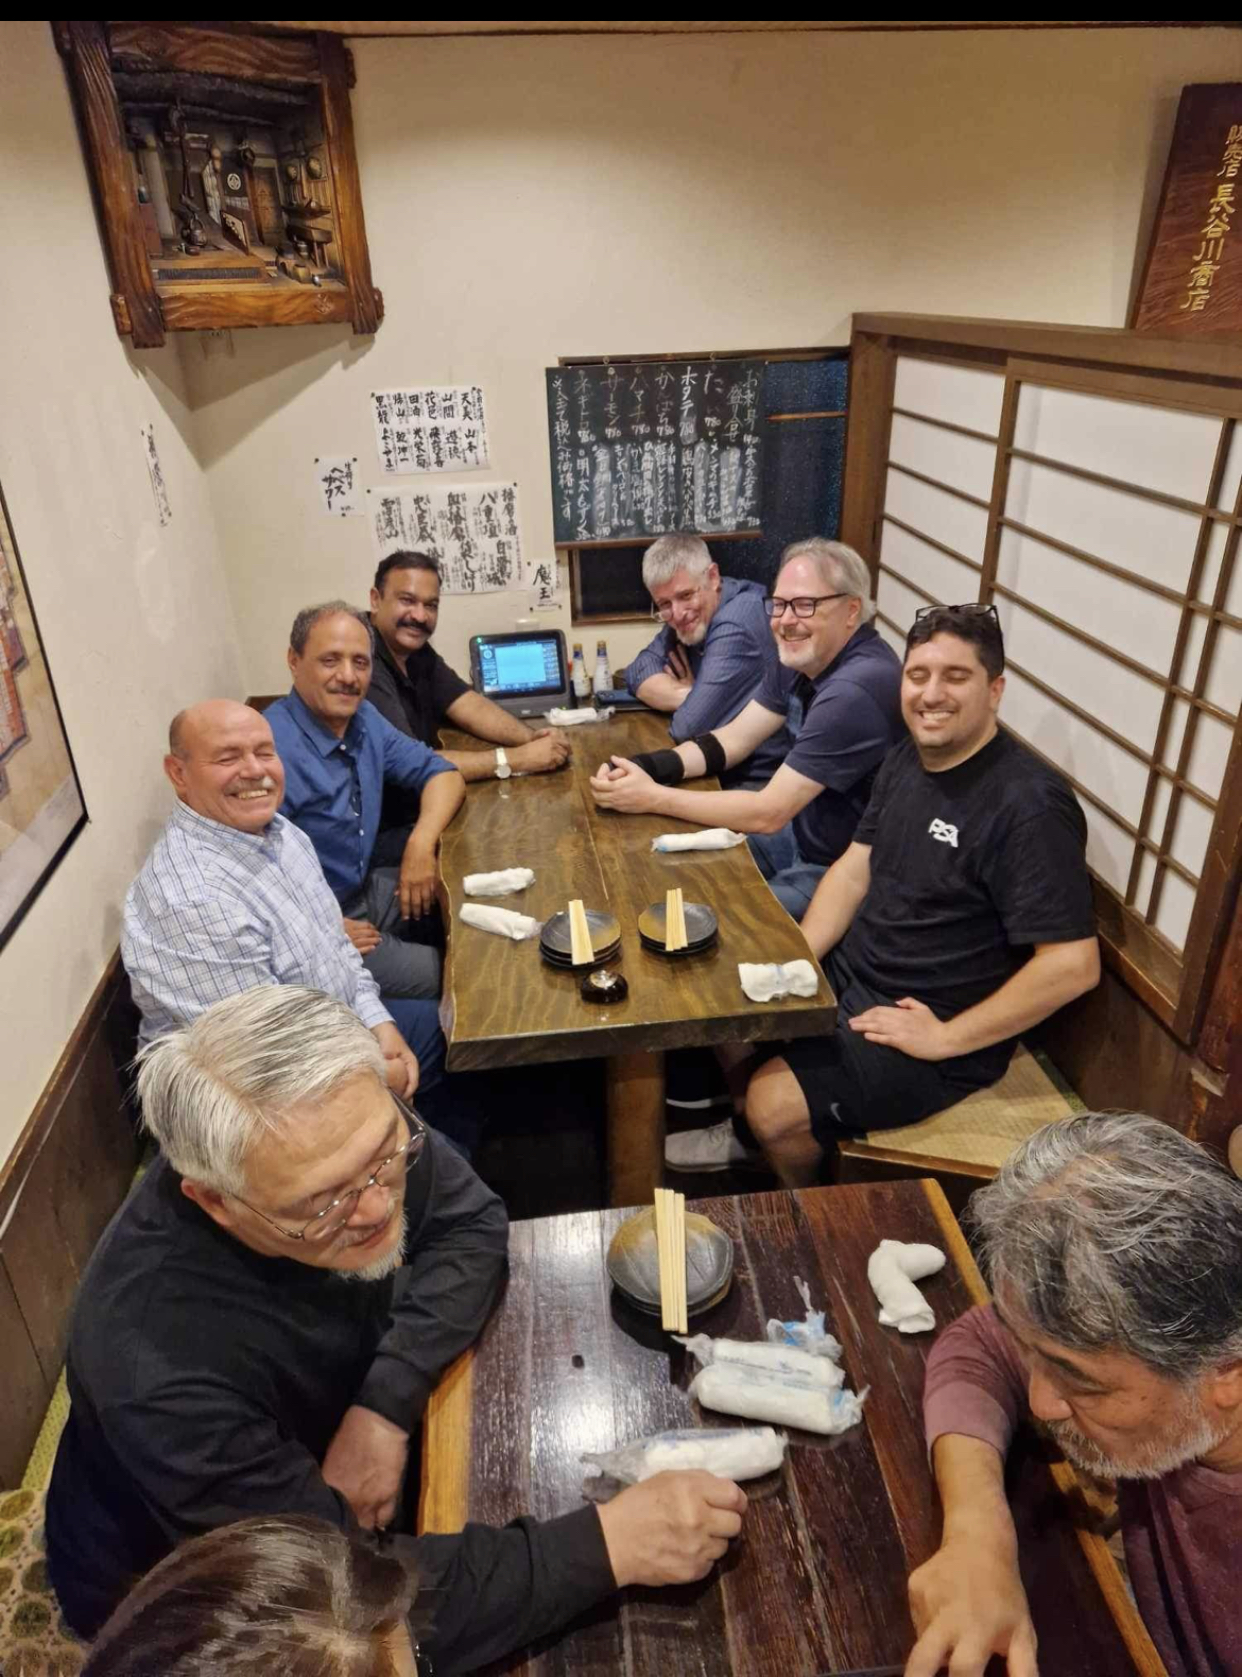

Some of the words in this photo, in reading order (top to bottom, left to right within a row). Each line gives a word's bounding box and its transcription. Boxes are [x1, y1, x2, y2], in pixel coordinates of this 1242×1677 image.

[1180, 183, 1236, 312] 長谷川商店
[573, 374, 592, 431] ネギトロ
[600, 374, 625, 426] サーモン
[629, 375, 649, 422] ハマチ
[681, 366, 698, 418] ホタテ
